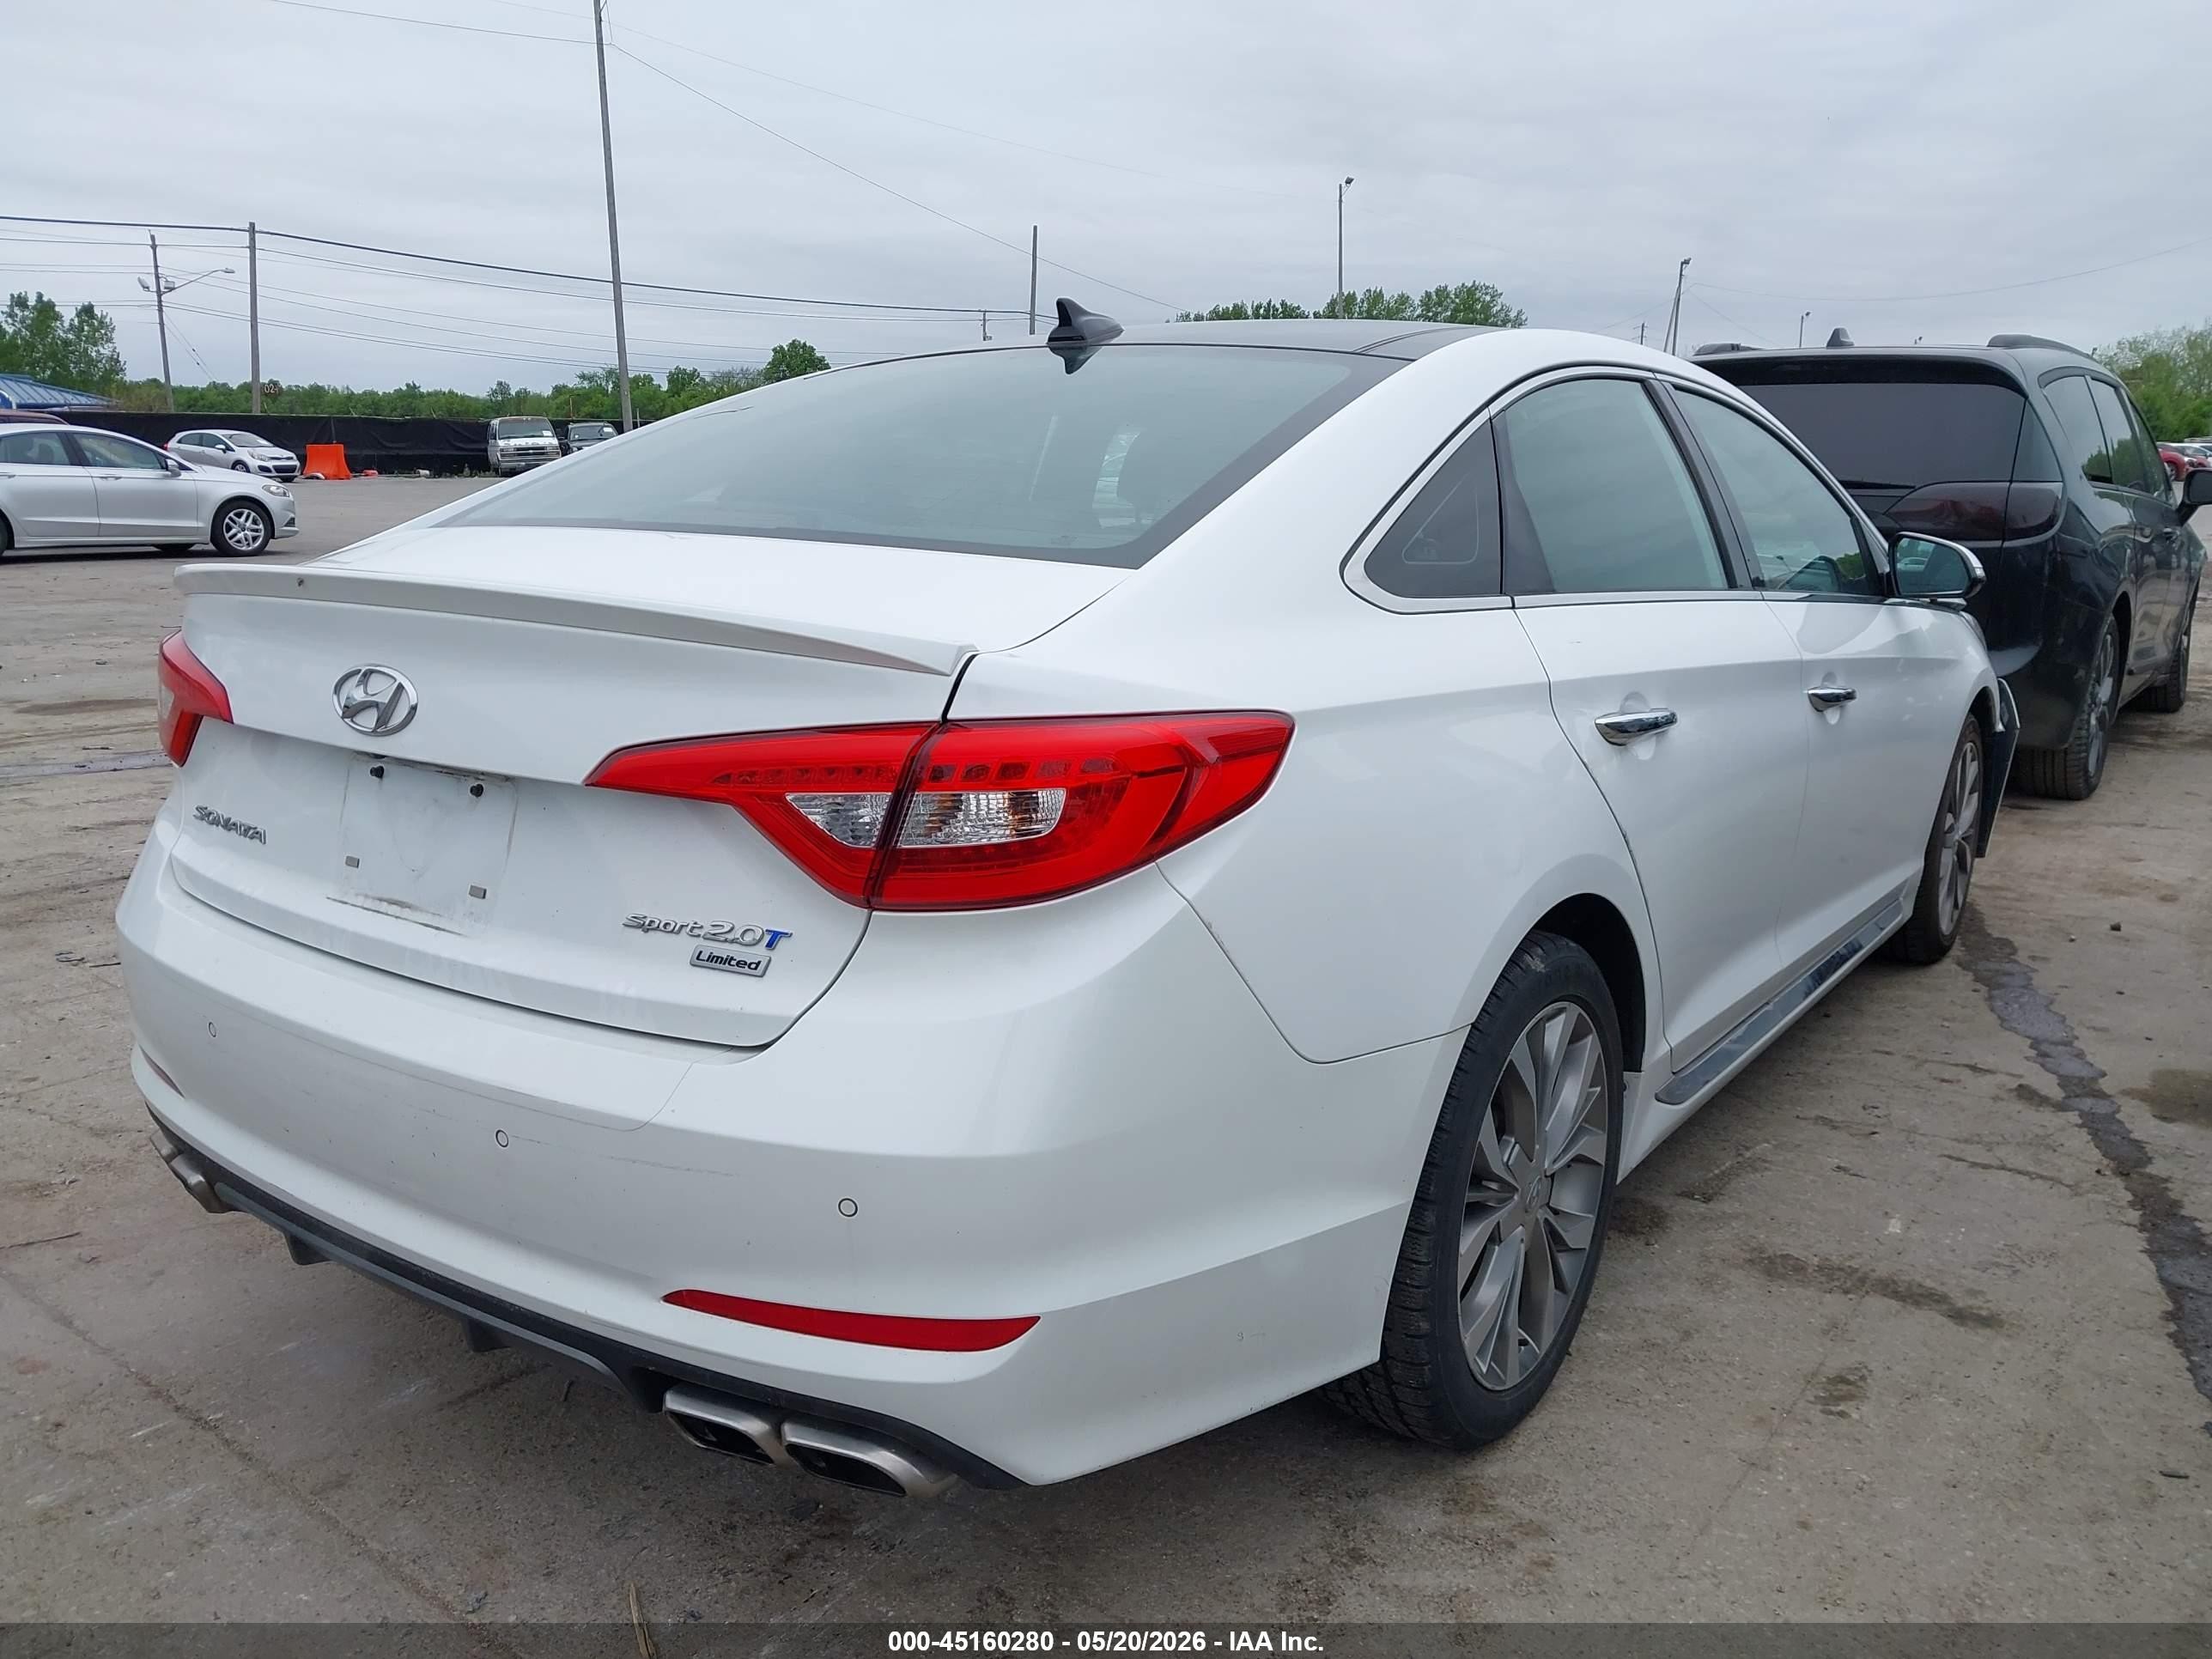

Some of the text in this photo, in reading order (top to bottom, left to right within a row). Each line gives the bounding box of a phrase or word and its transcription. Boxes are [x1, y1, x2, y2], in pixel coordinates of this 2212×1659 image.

[193, 805, 266, 844] SONATA
[622, 913, 793, 951] Sport 2.0T
[696, 951, 762, 972] Limited
